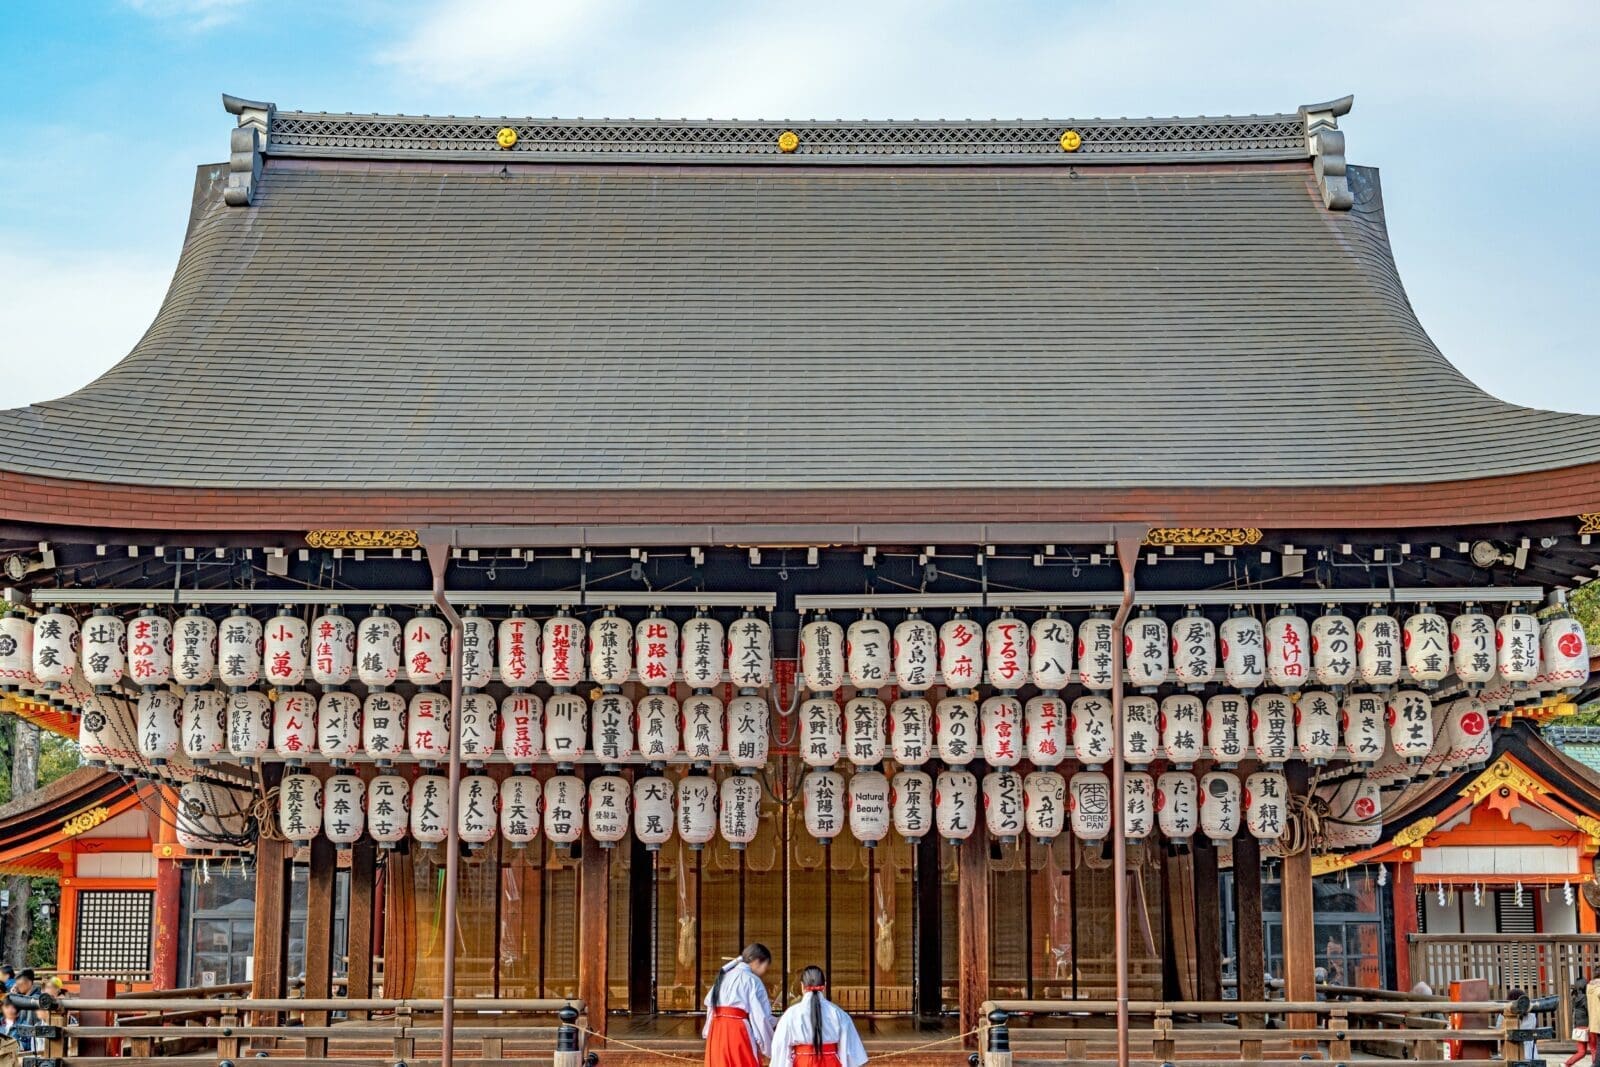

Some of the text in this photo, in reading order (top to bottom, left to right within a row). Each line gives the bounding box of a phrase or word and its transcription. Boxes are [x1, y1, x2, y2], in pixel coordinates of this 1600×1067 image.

[89, 625, 110, 674] 辻留
[134, 620, 157, 677] まめ弥
[271, 625, 293, 677] 小萬
[412, 626, 432, 674] 小愛
[509, 621, 527, 680] 下里香代子
[646, 624, 668, 679] 比路松
[695, 622, 711, 680] 井上安寿子
[742, 623, 762, 684] 井上八千代
[907, 625, 927, 685] 廣島屋
[952, 624, 973, 677] 多麻
[997, 624, 1020, 679] てる子
[1040, 623, 1066, 675] 丸八
[1094, 624, 1112, 684] 吉岡幸子
[1142, 624, 1162, 676] 岡あい
[1185, 623, 1208, 677] 房の家
[1328, 620, 1351, 676] みの竹
[1373, 622, 1392, 676] 備前屋
[1417, 618, 1443, 672] 松八重
[1472, 619, 1491, 673] ゑり萬
[1510, 636, 1524, 672] 美容室
[1525, 634, 1536, 667] アービル
[284, 697, 303, 752] だん香
[325, 697, 342, 749] キメラ
[371, 698, 390, 752] 池田家
[415, 700, 434, 750] 豆花
[462, 699, 480, 755] 美の八重
[555, 702, 572, 750] 川口
[601, 697, 621, 759] 茂山童司
[809, 704, 828, 759] 矢野一郎
[854, 704, 874, 759] 矢野一郎
[901, 706, 922, 760] 矢野一郎
[948, 705, 968, 756] みの家
[994, 704, 1014, 758] 小富美
[1038, 703, 1057, 756] 豆千鶴
[1084, 701, 1106, 757] やなぎ
[1127, 705, 1147, 753] 照豊
[1221, 701, 1240, 755] 田崎真也
[1359, 699, 1378, 753] 岡きみ
[332, 779, 351, 835] 元奈古
[375, 782, 394, 835] 元奈古
[644, 784, 664, 834] 大晃
[816, 776, 834, 832] 小松陽一郎
[855, 792, 884, 801] Natural
[856, 804, 883, 814] Beauty
[950, 776, 967, 830] いちえ
[998, 774, 1018, 830] おくむら
